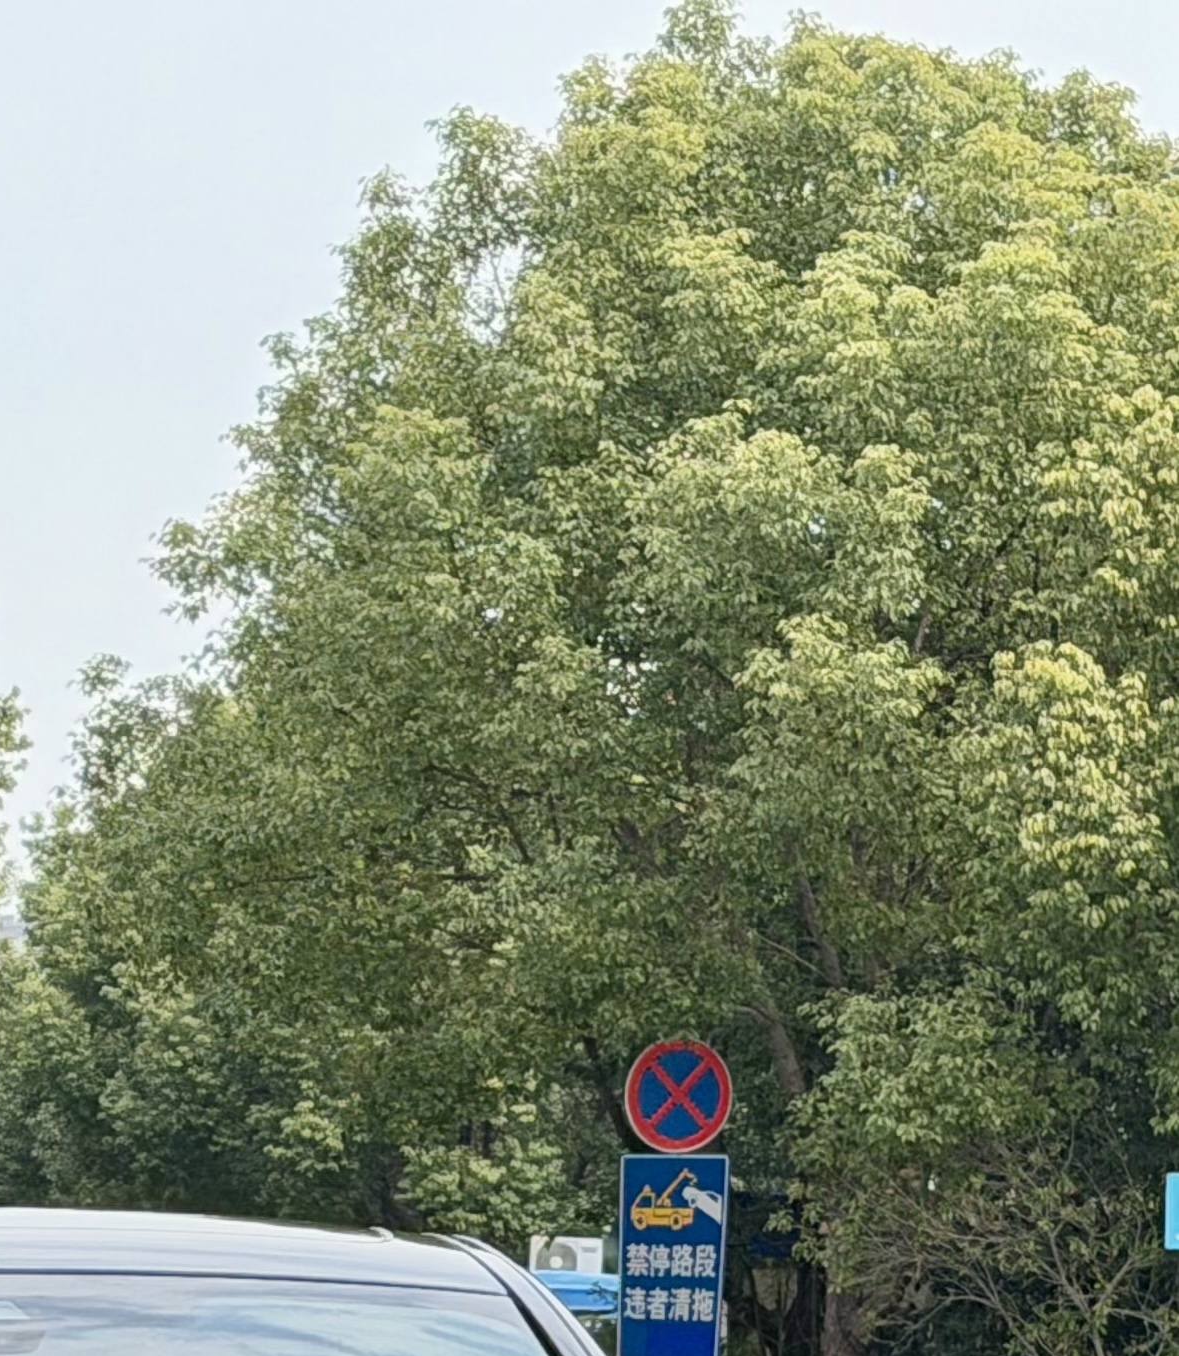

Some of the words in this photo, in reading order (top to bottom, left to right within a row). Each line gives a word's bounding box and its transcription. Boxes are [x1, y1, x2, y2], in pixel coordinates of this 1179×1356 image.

[626, 1243, 717, 1277] 禁停路段
[624, 1287, 715, 1321] 违者清拖
